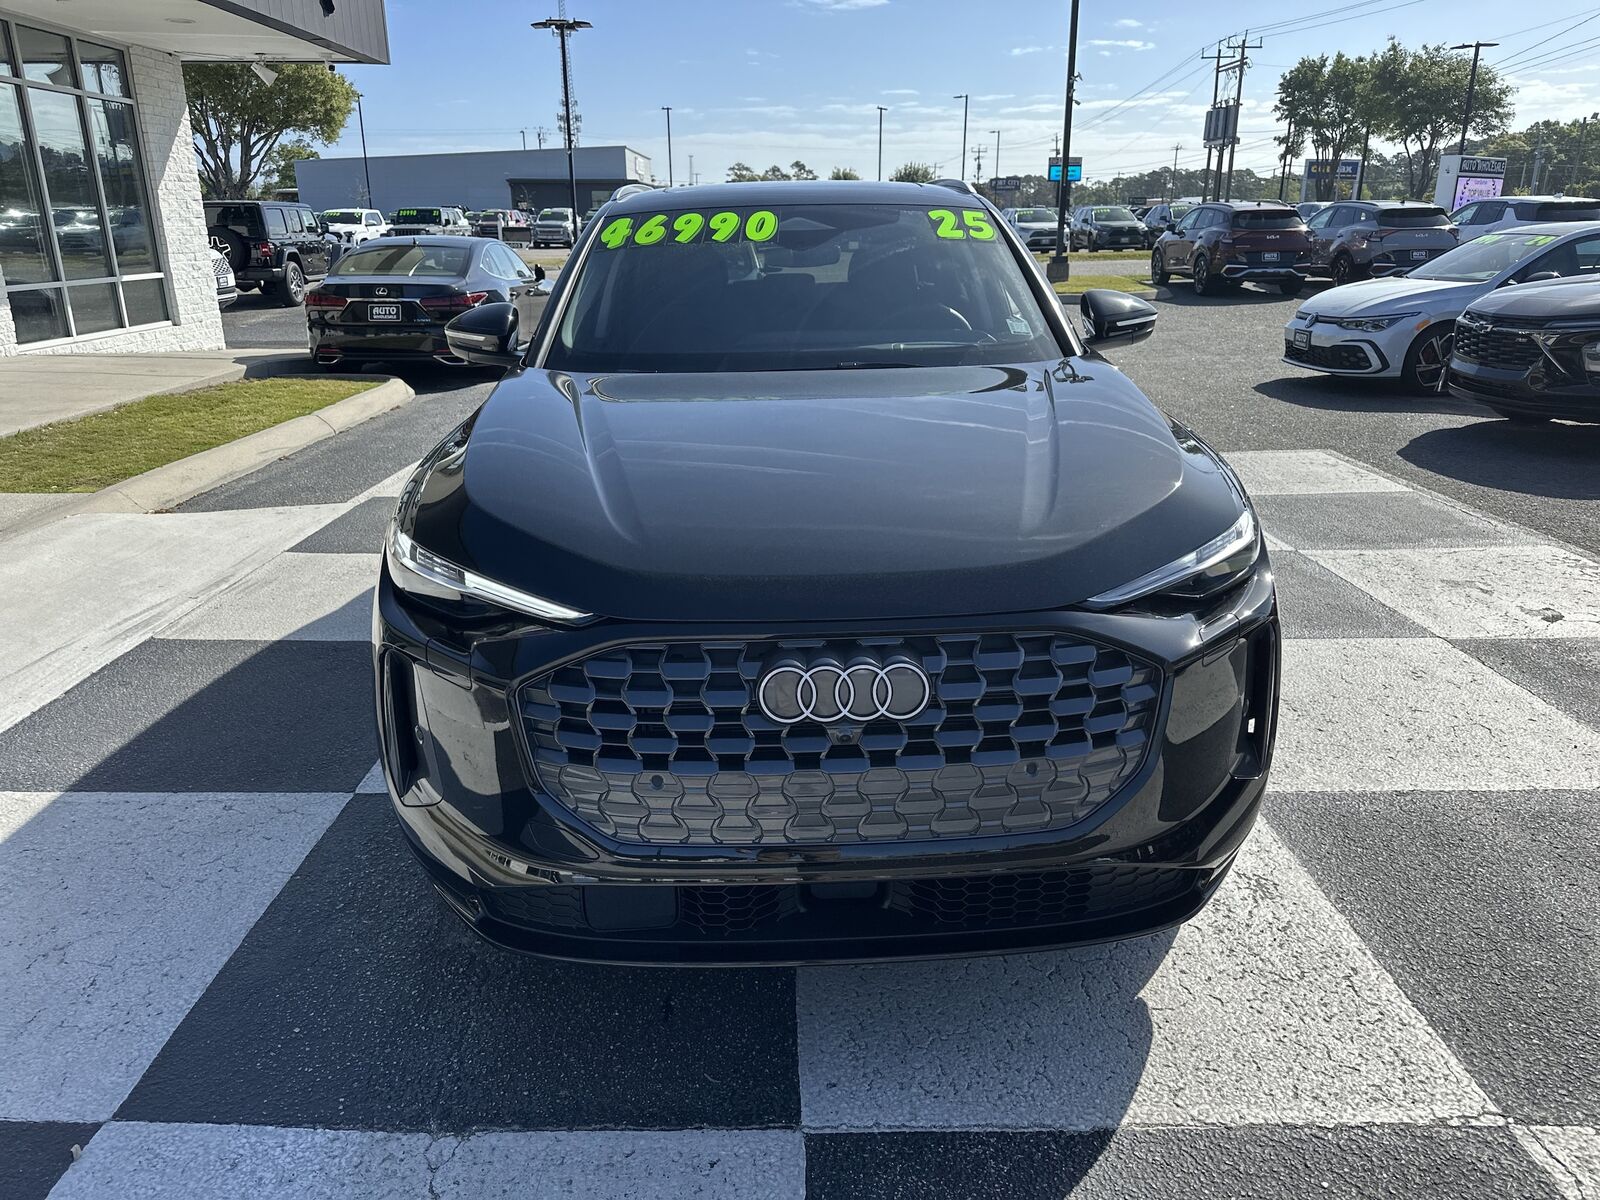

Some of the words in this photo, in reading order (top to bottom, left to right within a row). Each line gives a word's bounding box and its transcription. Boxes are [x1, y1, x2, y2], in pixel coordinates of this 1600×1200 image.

[1462, 160, 1476, 171] AUTO
[1477, 160, 1505, 173] WHOLESALE
[600, 210, 779, 249] 46990
[927, 209, 997, 241] 25
[372, 306, 397, 315] AUTO
